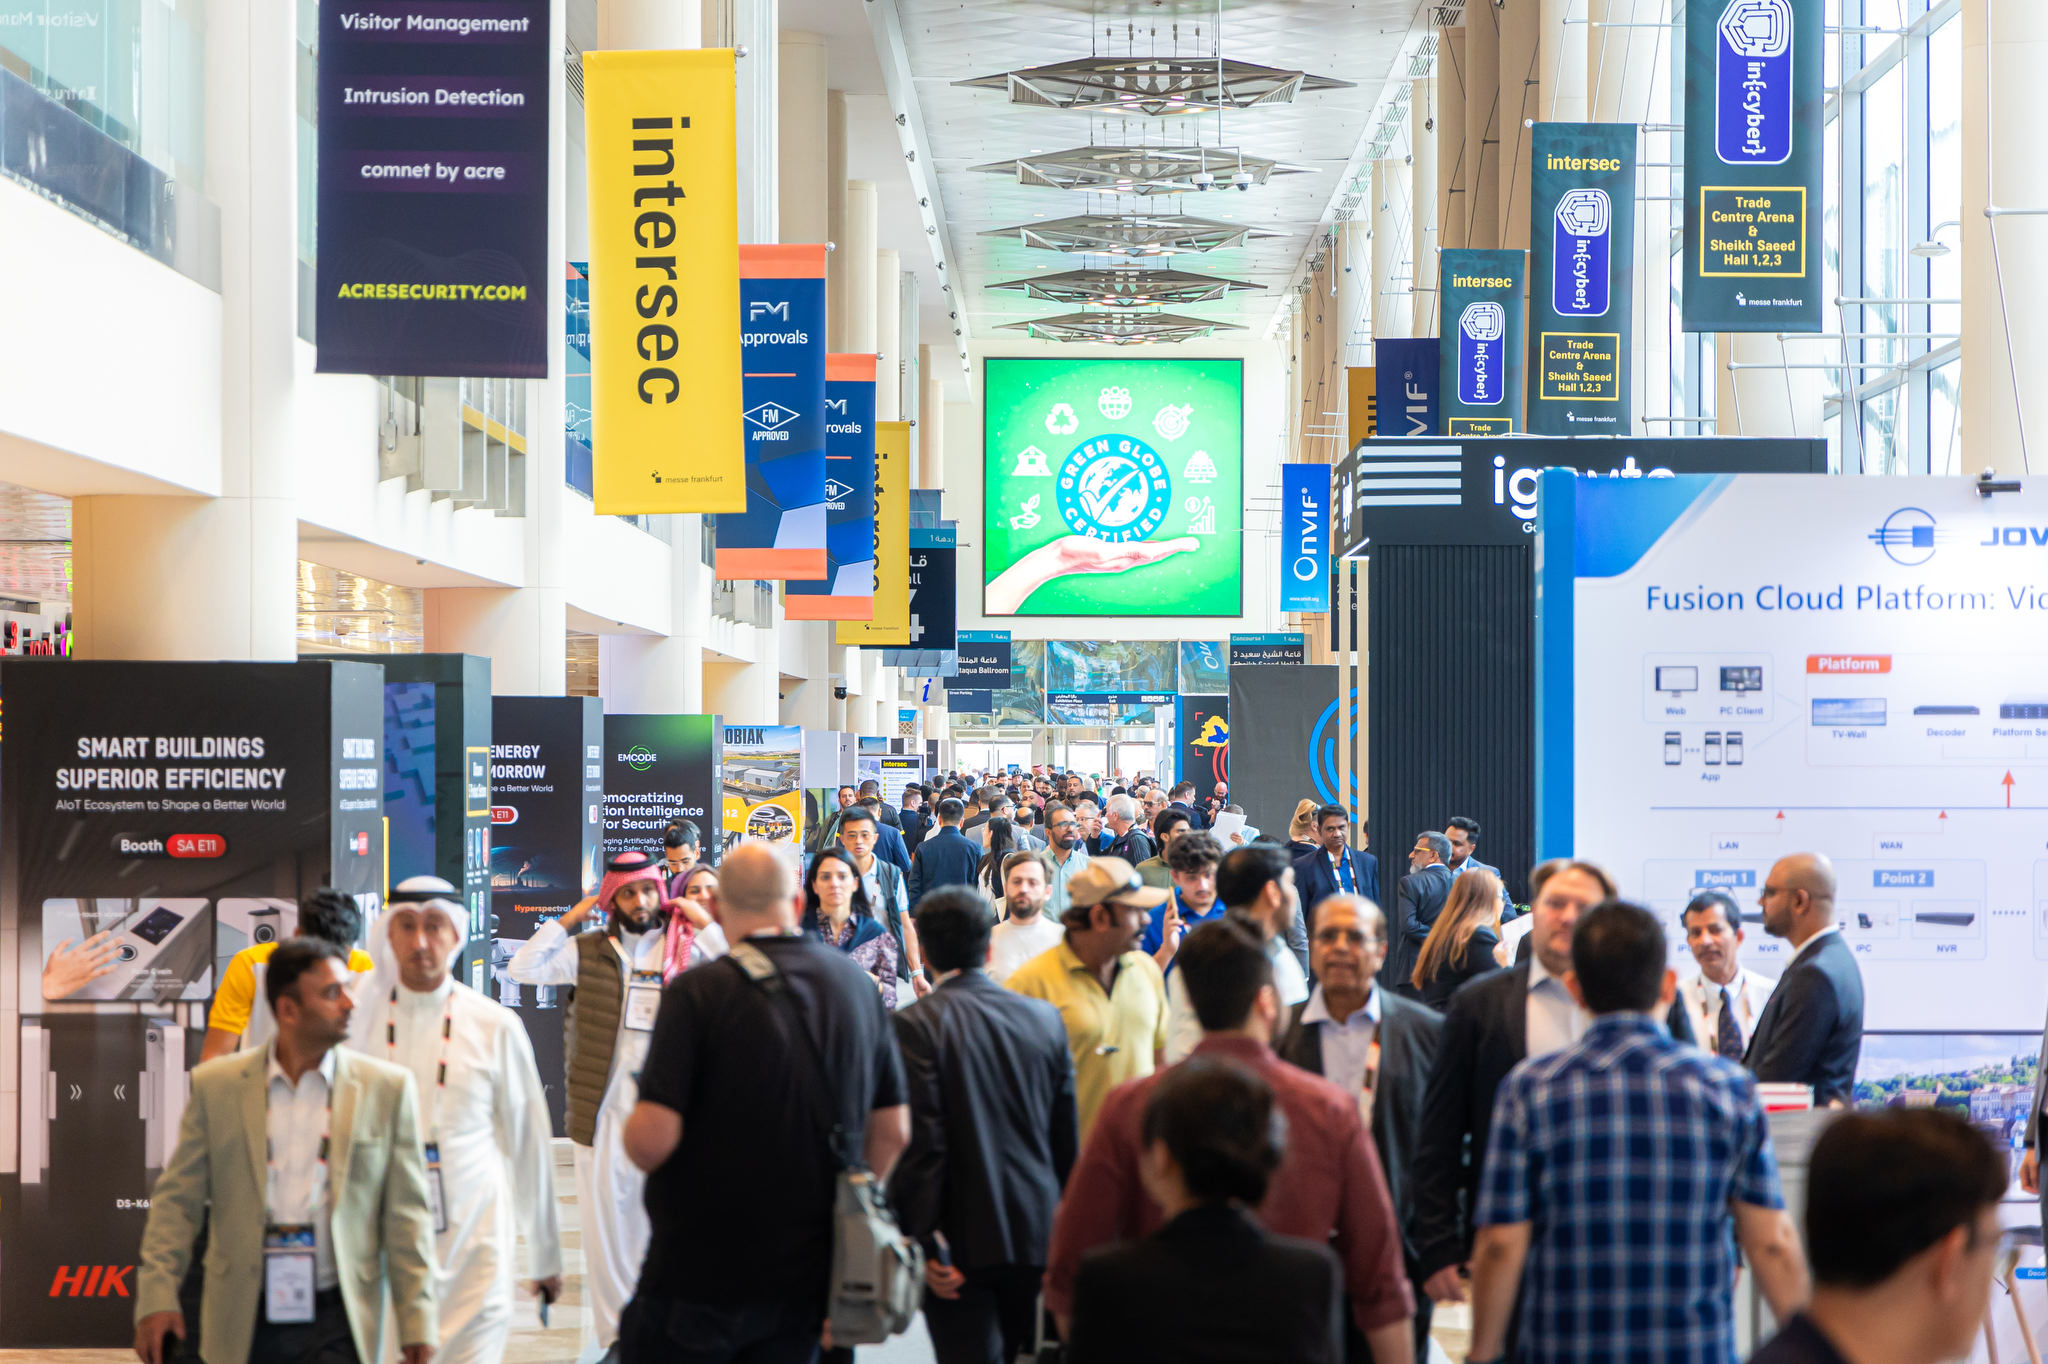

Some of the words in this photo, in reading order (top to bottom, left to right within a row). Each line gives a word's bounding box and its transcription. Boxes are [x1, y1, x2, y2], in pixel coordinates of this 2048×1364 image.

[340, 13, 402, 30] Visitor
[406, 15, 530, 35] Management
[343, 87, 430, 105] Intrusion
[434, 88, 525, 106] Detection
[1547, 153, 1621, 171] intersec
[360, 162, 431, 180] comnet
[436, 162, 459, 184] by
[463, 164, 506, 180] acre
[1735, 196, 1772, 209] Trade
[1711, 210, 1754, 223] Centre
[1757, 211, 1795, 223] Arena
[1748, 225, 1758, 237] &
[1710, 239, 1754, 251] Sheikh
[1757, 240, 1796, 252] Saeed
[632, 116, 691, 406] intersec
[1723, 253, 1749, 265] Hall
[1752, 254, 1782, 267] 1,2,3
[1452, 274, 1513, 289] intersec
[337, 283, 527, 301] ACRESECURITY.COM
[1772, 298, 1803, 307] frankfurt
[750, 302, 790, 322] FM
[1567, 339, 1594, 350] Trade
[1549, 350, 1581, 360] Centre
[1583, 351, 1612, 361] Arena
[1576, 361, 1584, 371] &
[1548, 371, 1580, 381] Sheikh
[1583, 372, 1612, 382] Saeed
[1558, 382, 1577, 392] Hall
[1579, 383, 1602, 393] 1,2,3
[762, 409, 779, 424] FM
[826, 422, 862, 433] rovals
[1469, 423, 1492, 432] Trade
[752, 431, 790, 441] APPROVED
[1061, 440, 1109, 489] GREEN
[1119, 440, 1166, 490] GLOBE
[665, 476, 689, 484] messe
[691, 475, 723, 483] frankfurt
[1065, 507, 1162, 543] CERTIFIED
[1646, 584, 1744, 612] Fusion
[1754, 584, 1844, 612] Cloud
[1856, 584, 1996, 612] Platform:
[1817, 656, 1880, 672] Platform
[978, 666, 1009, 675] Ballroom
[1665, 706, 1687, 716] Web
[1719, 706, 1733, 716] PC
[1736, 706, 1764, 716] Client
[722, 727, 765, 745] OBIAK
[1832, 729, 1867, 740] TV-Wall
[1926, 727, 1966, 738] Decoder
[1992, 727, 2032, 738] Platform
[76, 736, 149, 760] SMART
[155, 736, 265, 760] BUILDINGS
[617, 753, 657, 762] EMCODE
[55, 767, 159, 790] SUPERIOR
[164, 767, 287, 790] EFFICIENCY
[1701, 771, 1721, 782] App
[507, 784, 530, 792] Better
[531, 784, 554, 792] World
[84, 799, 145, 812] Ecosystem
[147, 799, 159, 811] to
[161, 799, 199, 813] Shape
[201, 801, 210, 810] a
[212, 799, 249, 811] Better
[250, 799, 286, 811] World
[627, 805, 704, 819] Intelligence
[622, 818, 671, 830] Securit
[120, 838, 164, 852] Booth
[176, 839, 196, 852] SA
[197, 839, 217, 852] E11
[623, 837, 658, 846] Artificially
[1718, 841, 1740, 850] LAN
[1880, 841, 1904, 851] WAN
[1703, 872, 1738, 885] Point
[1741, 873, 1748, 884] 1
[1880, 872, 1914, 886] Point
[1917, 872, 1927, 885] 2
[514, 904, 572, 913] Hyperspectral
[1758, 944, 1779, 953] NVR
[1856, 943, 1872, 953] IPC
[1936, 944, 1957, 953] NVR
